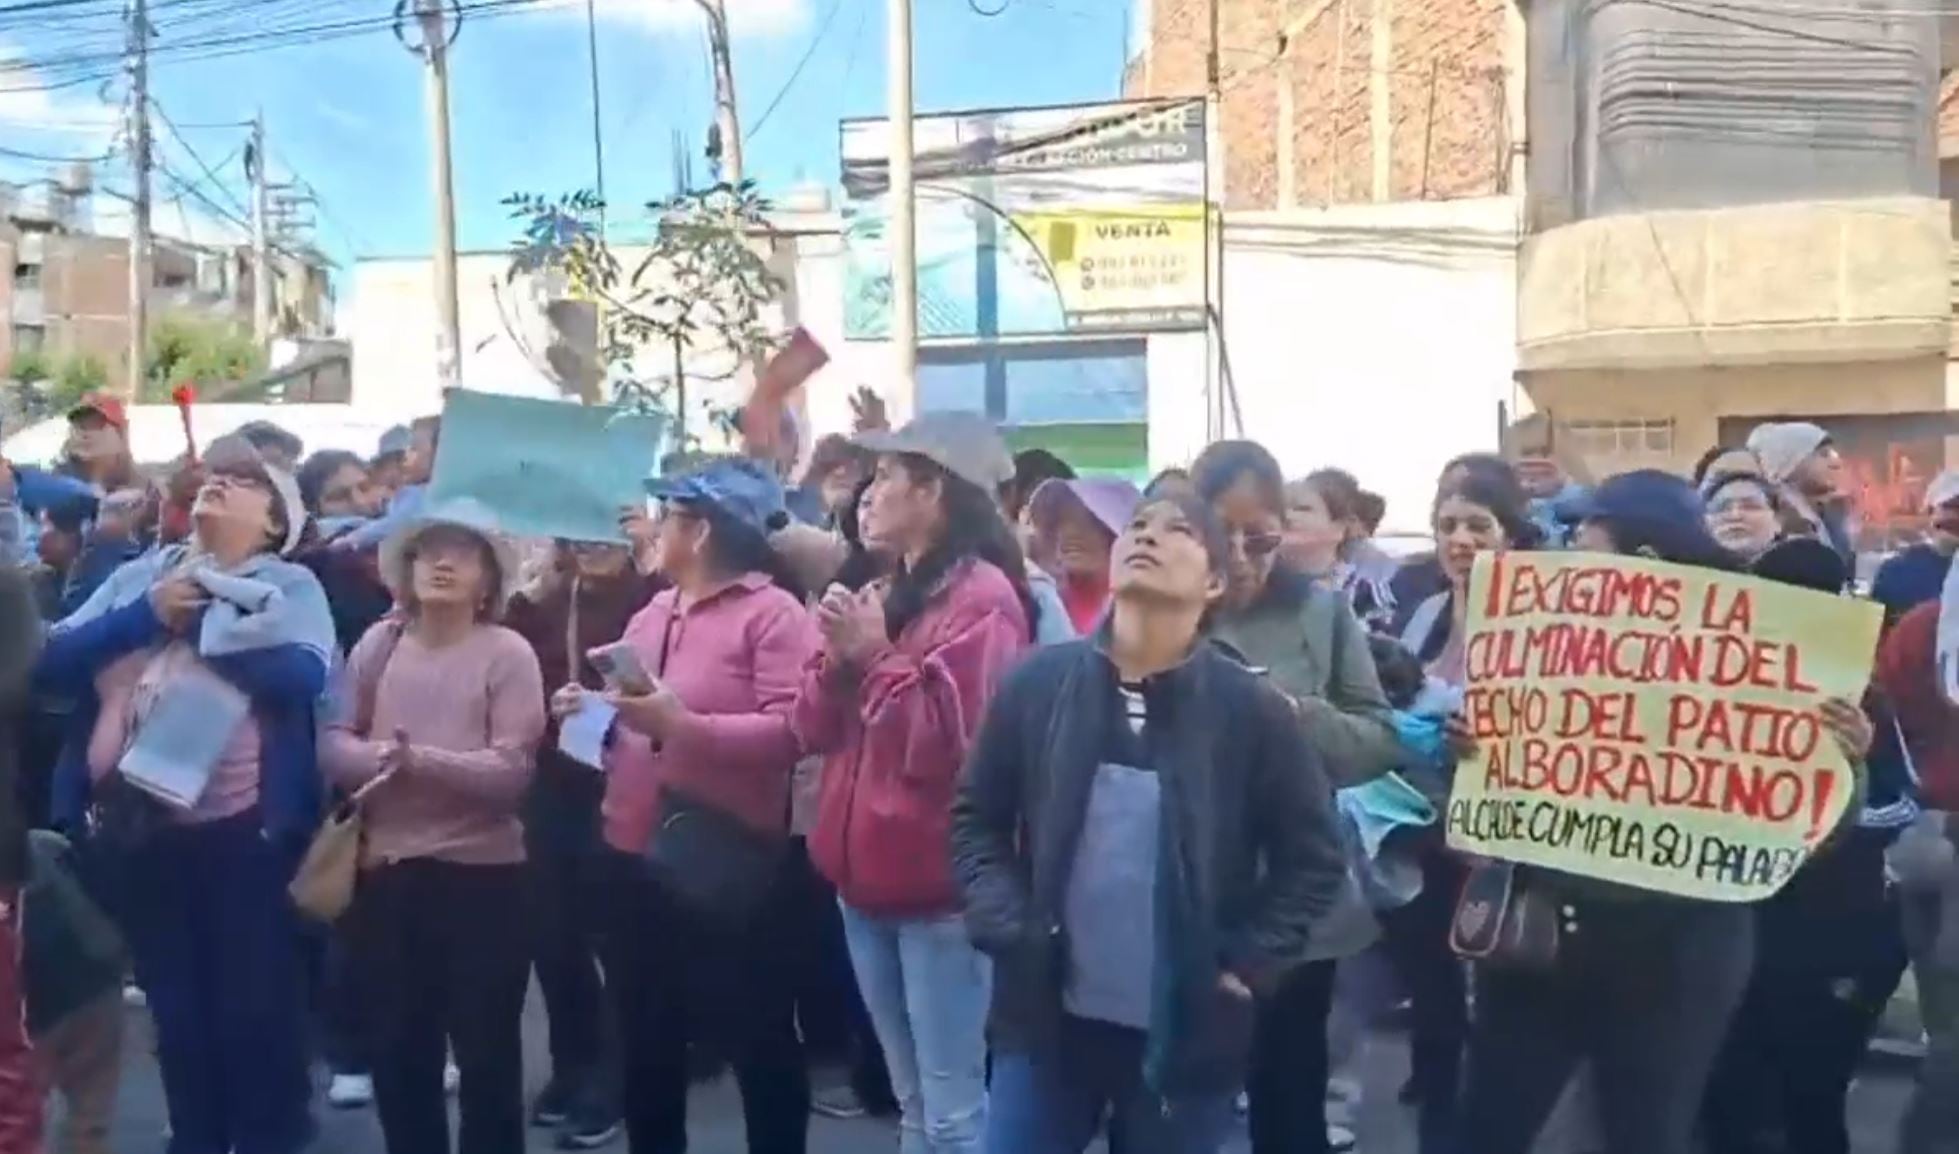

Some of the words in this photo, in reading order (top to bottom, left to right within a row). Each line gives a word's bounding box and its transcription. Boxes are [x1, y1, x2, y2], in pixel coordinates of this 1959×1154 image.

[1095, 220, 1171, 240] VENTA
[1701, 582, 1753, 634] LA
[1467, 623, 1701, 683] CULMINACIÓN
[1708, 634, 1818, 694] DEL
[1556, 688, 1646, 742] DEL
[1667, 694, 1820, 761] PATIO
[1529, 801, 1644, 860] CUMPLA
[1652, 823, 1692, 868] SU
